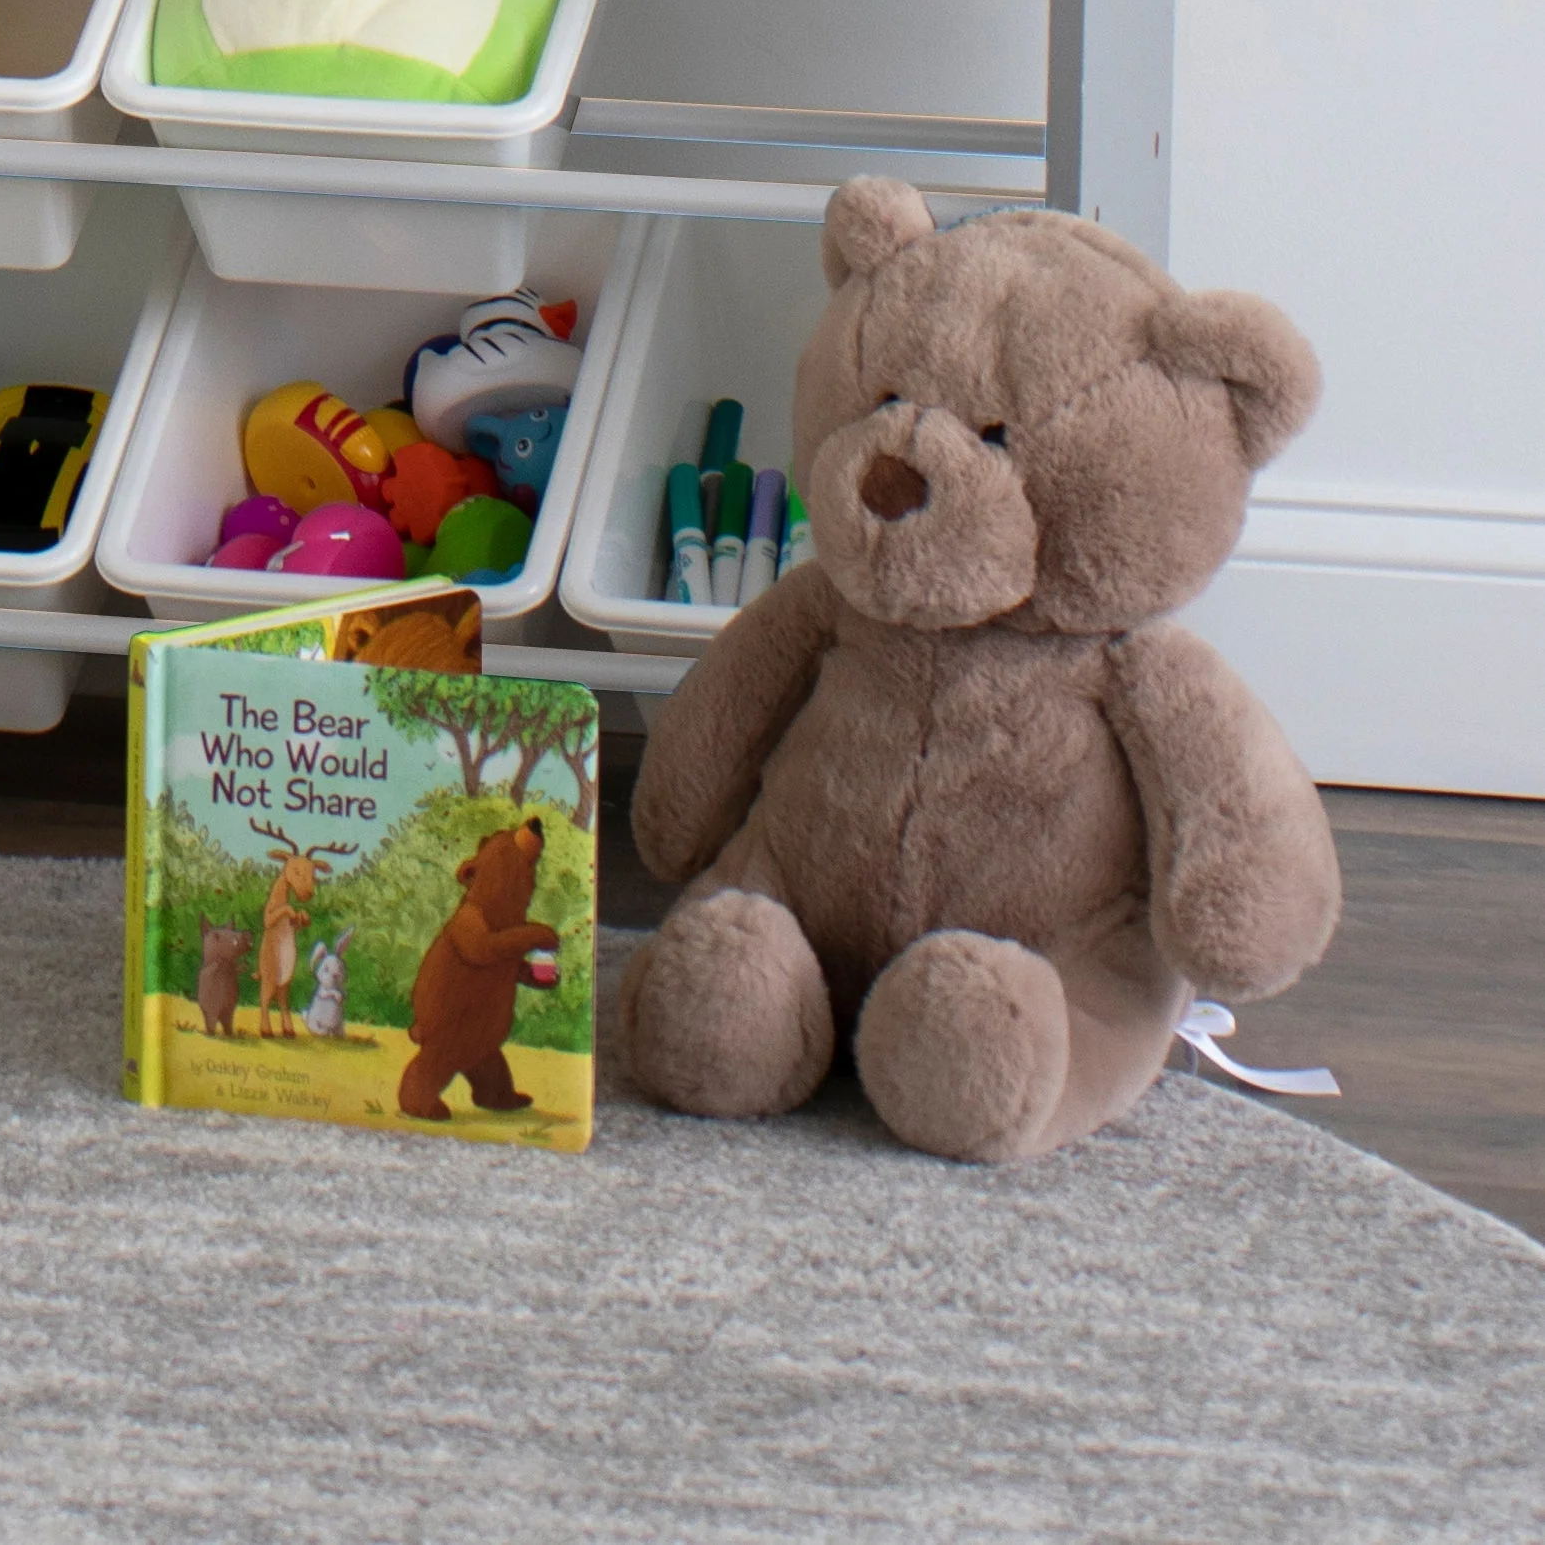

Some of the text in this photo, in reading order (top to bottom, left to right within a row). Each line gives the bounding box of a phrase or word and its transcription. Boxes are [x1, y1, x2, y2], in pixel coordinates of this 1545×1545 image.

[220, 692, 370, 739] The Bear
[201, 730, 388, 780] Who Would
[212, 769, 377, 820] Not Share
